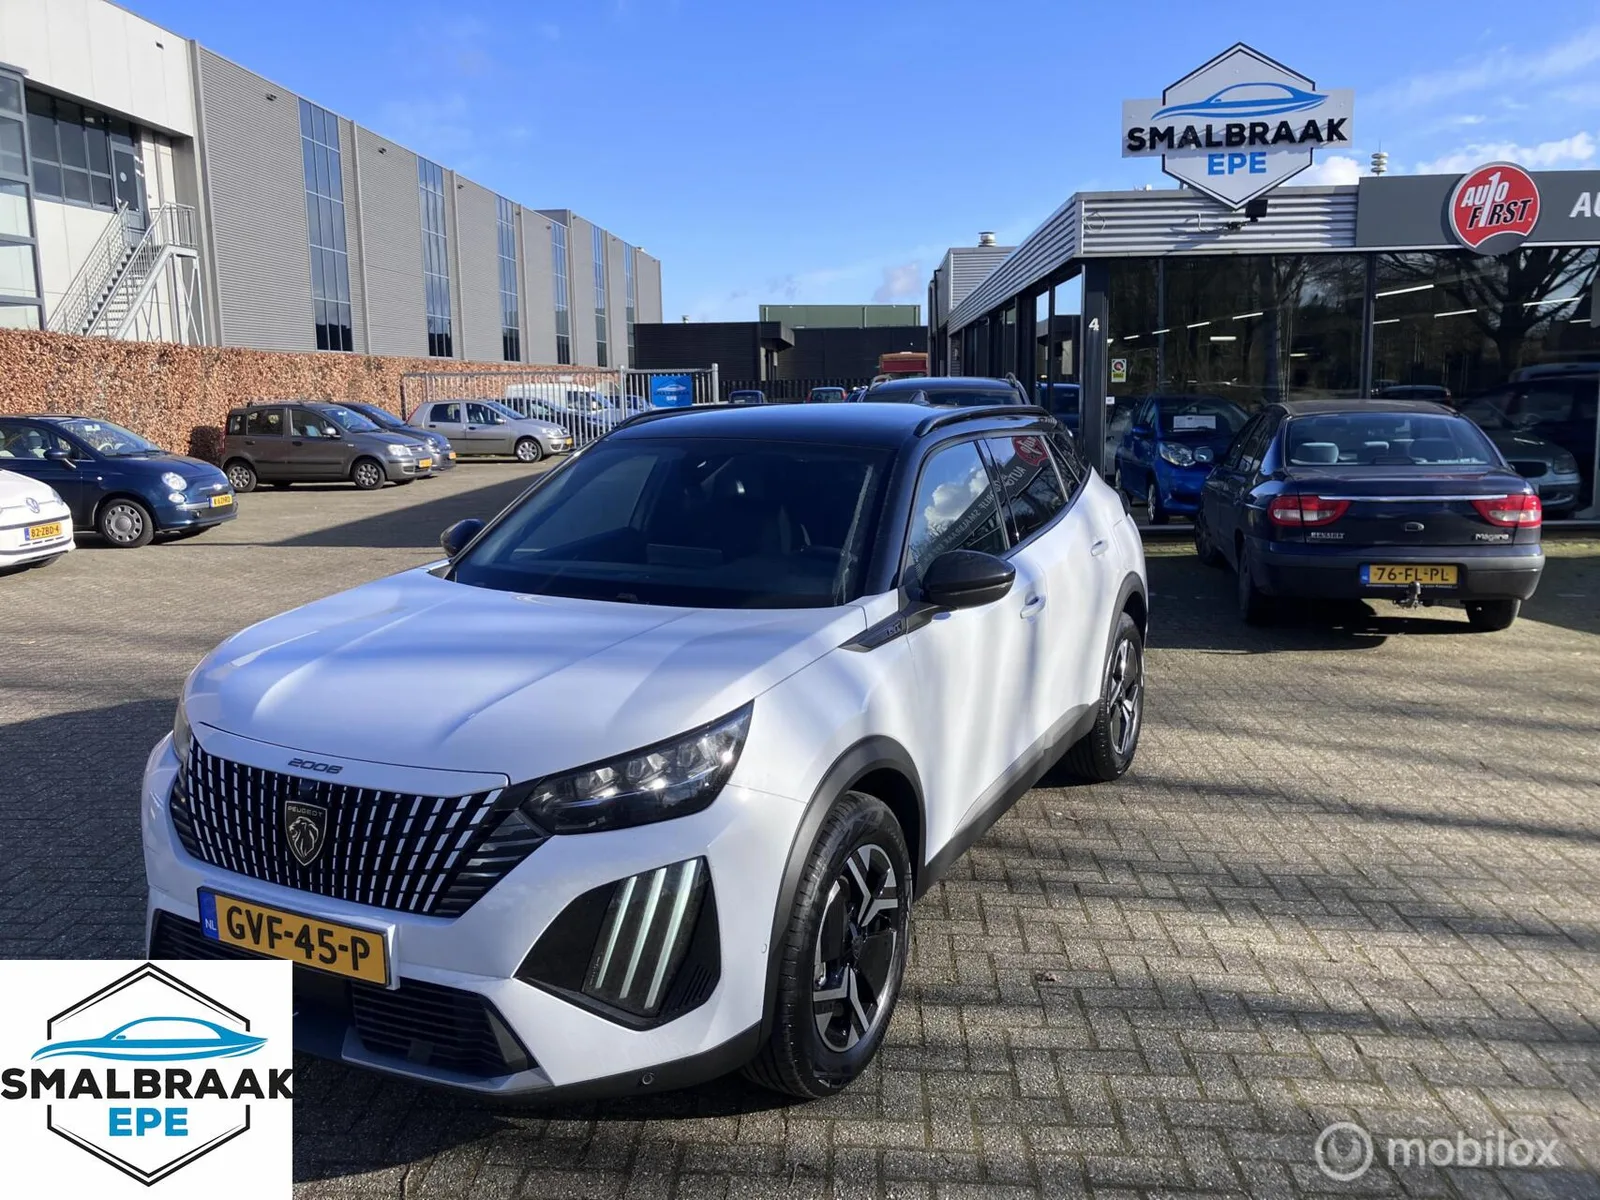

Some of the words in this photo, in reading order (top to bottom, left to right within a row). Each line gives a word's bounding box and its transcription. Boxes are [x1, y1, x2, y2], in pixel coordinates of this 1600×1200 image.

[1127, 117, 1348, 152] SMALBRAAK
[1207, 151, 1267, 176] EPE
[1088, 317, 1100, 331] 4
[1376, 567, 1449, 582] 76-FL-PL
[287, 757, 344, 775] 2008
[287, 805, 323, 817] PEUGEOT
[204, 918, 217, 931] NL
[226, 905, 371, 971] GVF-45-P
